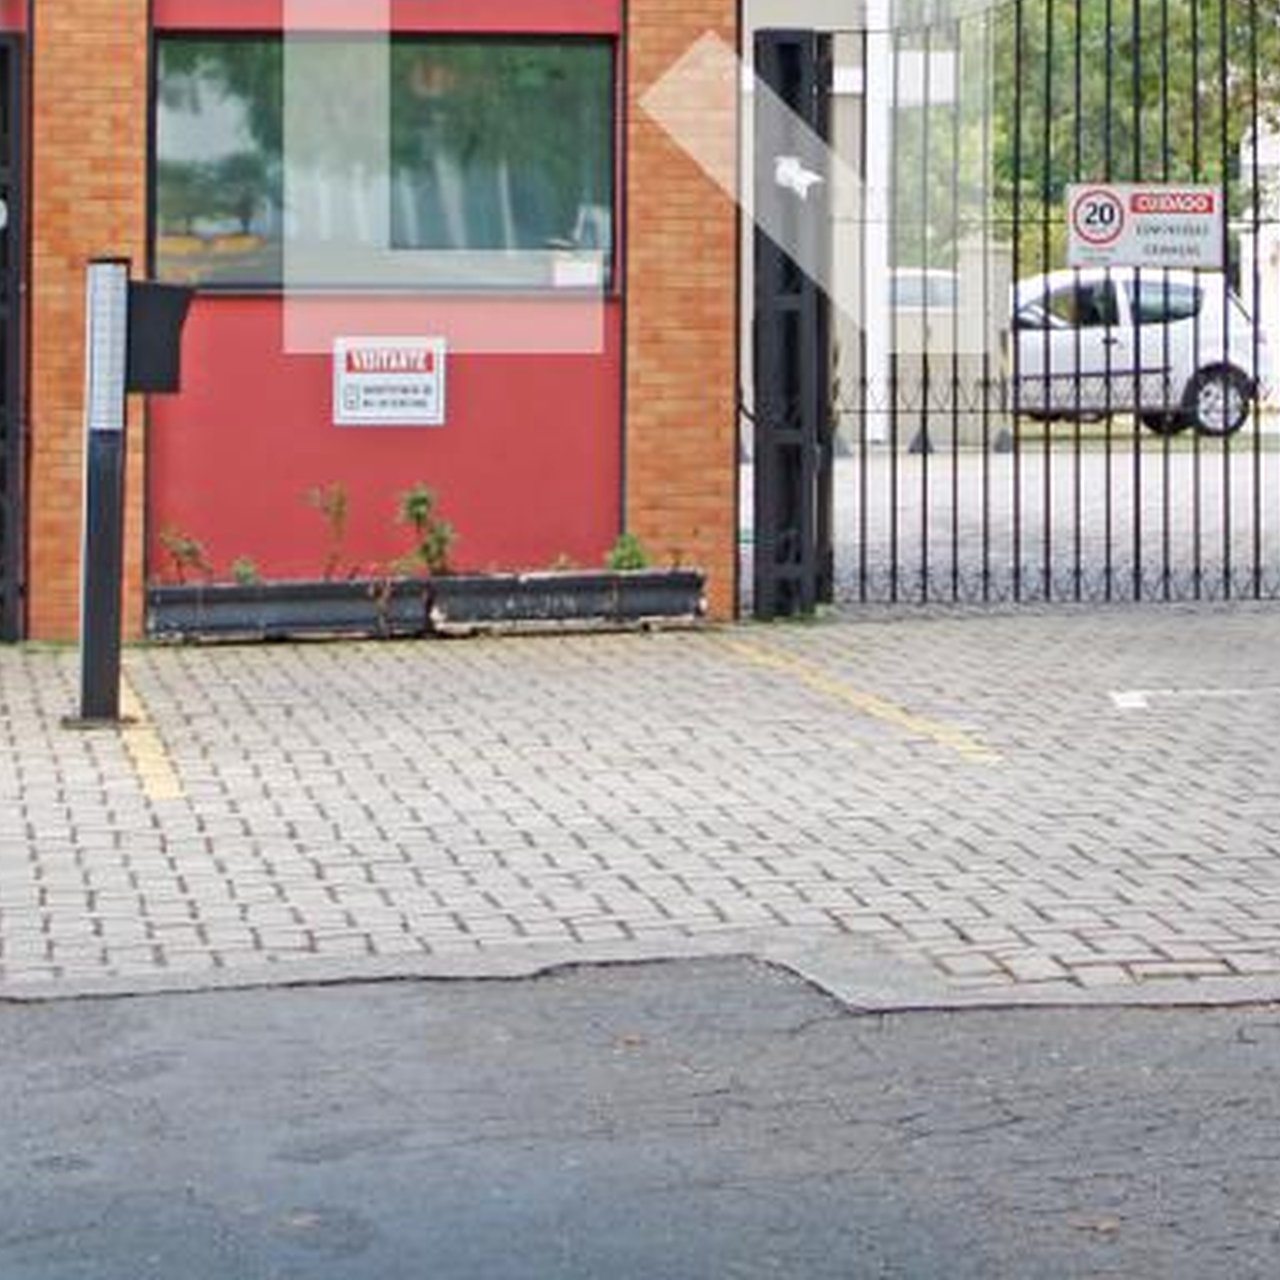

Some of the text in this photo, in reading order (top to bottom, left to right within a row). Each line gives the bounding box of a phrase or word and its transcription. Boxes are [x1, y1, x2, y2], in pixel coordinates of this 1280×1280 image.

[1136, 193, 1208, 211] CUIDADO
[1085, 201, 1115, 224] 20
[351, 349, 426, 369] VISITANTE
